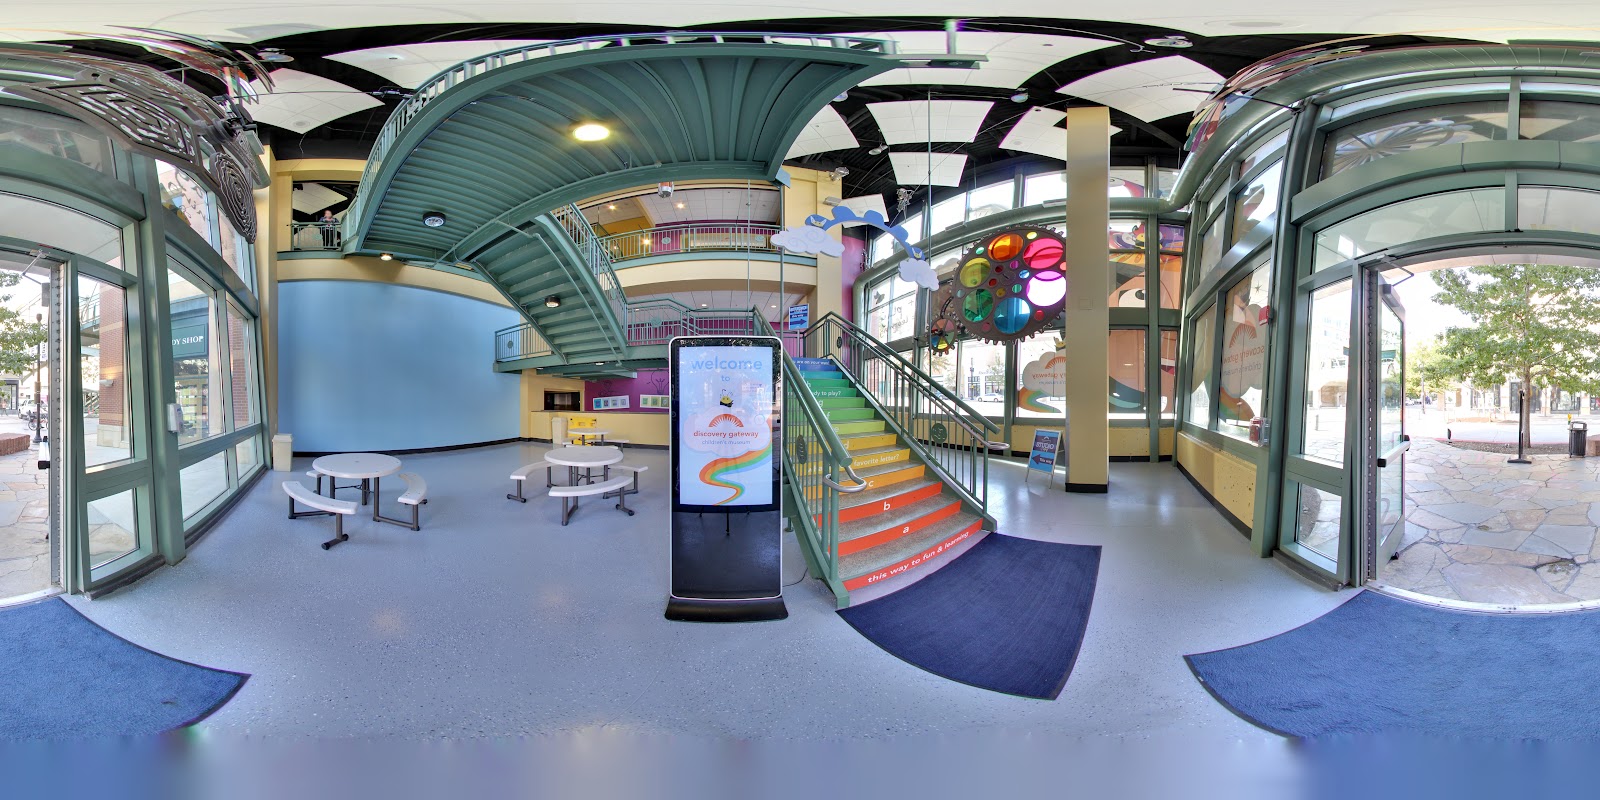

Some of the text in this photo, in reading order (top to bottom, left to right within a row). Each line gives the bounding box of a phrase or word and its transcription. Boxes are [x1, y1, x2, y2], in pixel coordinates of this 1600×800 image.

[182, 335, 204, 344] SHOP
[691, 355, 763, 370] welcome
[693, 430, 759, 439] discovery gateway
[1035, 442, 1054, 450] STUDIO
[853, 453, 900, 467] favorite letter?
[883, 501, 891, 511] b
[902, 526, 910, 534] a
[867, 531, 969, 583] this way to fun & learning
